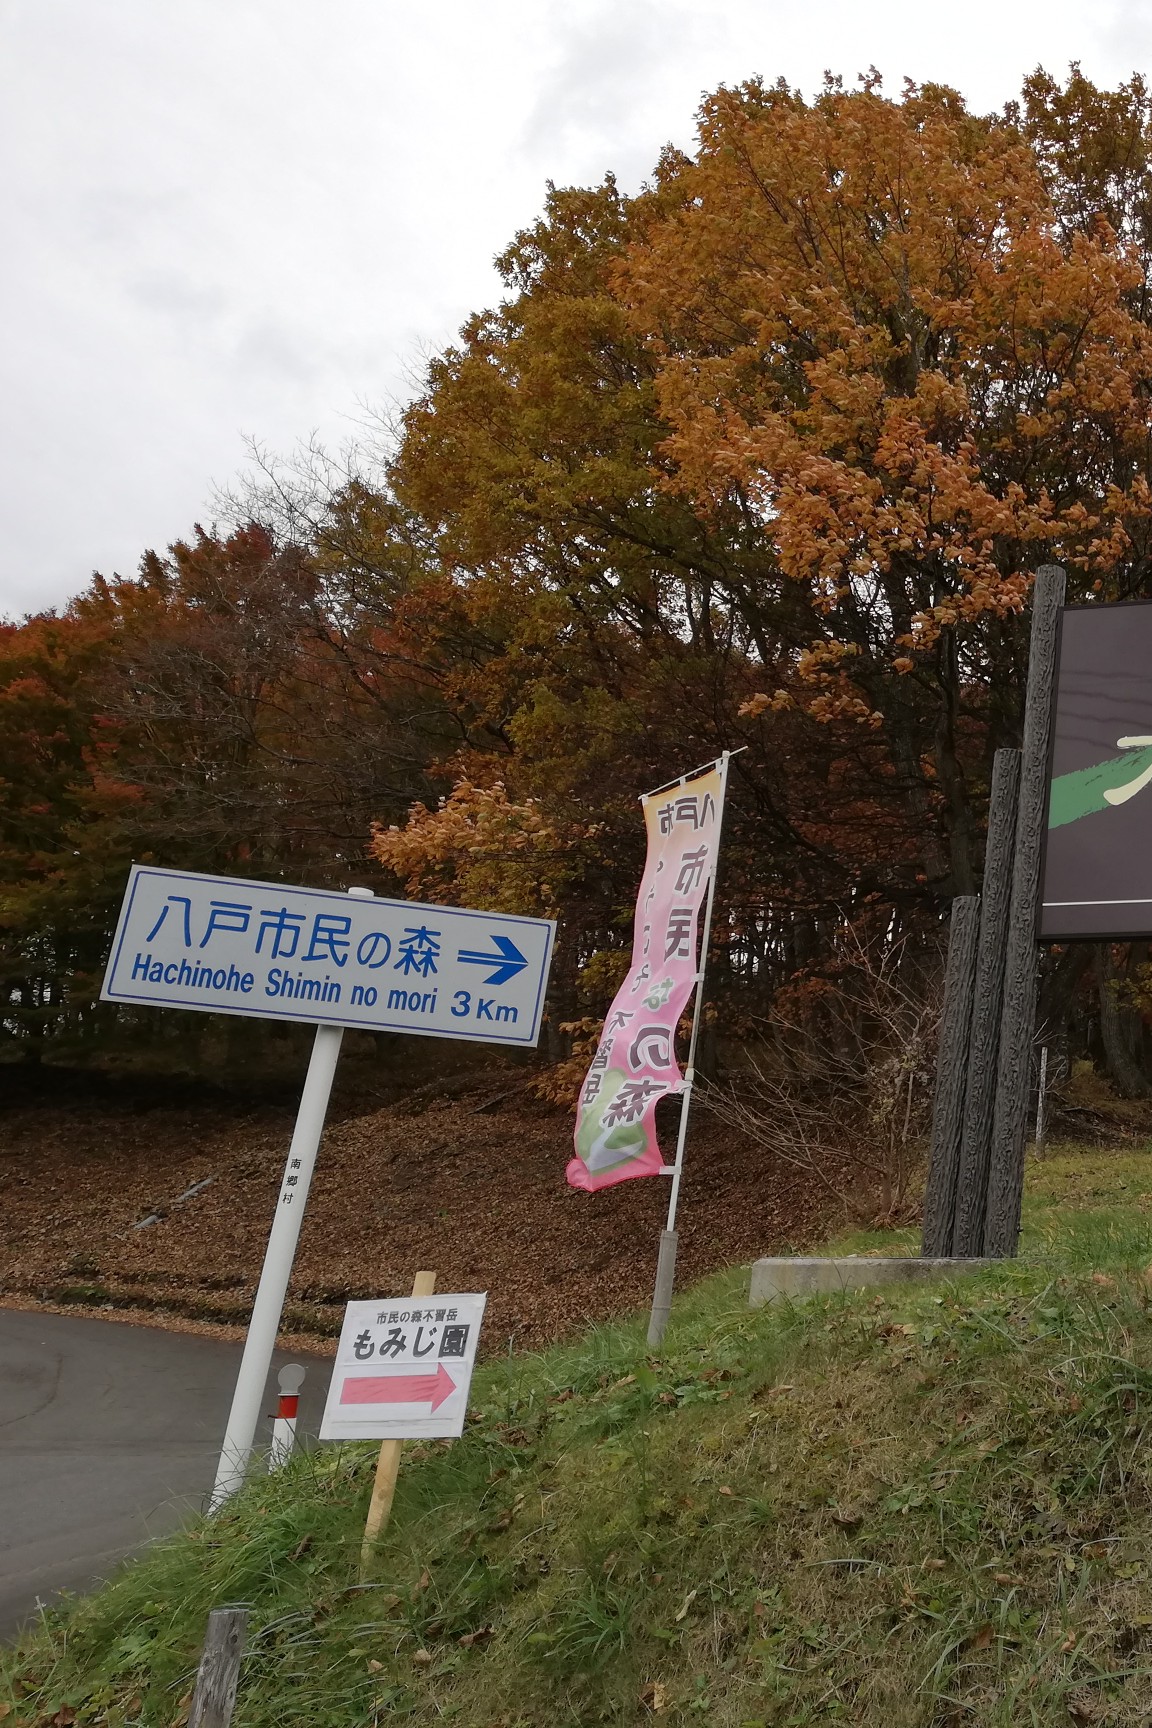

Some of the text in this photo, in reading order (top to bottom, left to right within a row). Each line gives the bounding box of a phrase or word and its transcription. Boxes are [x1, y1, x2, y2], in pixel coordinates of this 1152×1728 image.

[146, 895, 441, 978] 八戸市民の森
[131, 953, 254, 993] Hachinohe
[265, 968, 341, 1004] Shimin
[350, 984, 378, 1007] no
[387, 988, 437, 1013] mori
[376, 1308, 458, 1325] 市民の森不習岳
[353, 1324, 471, 1361] もみじ園
